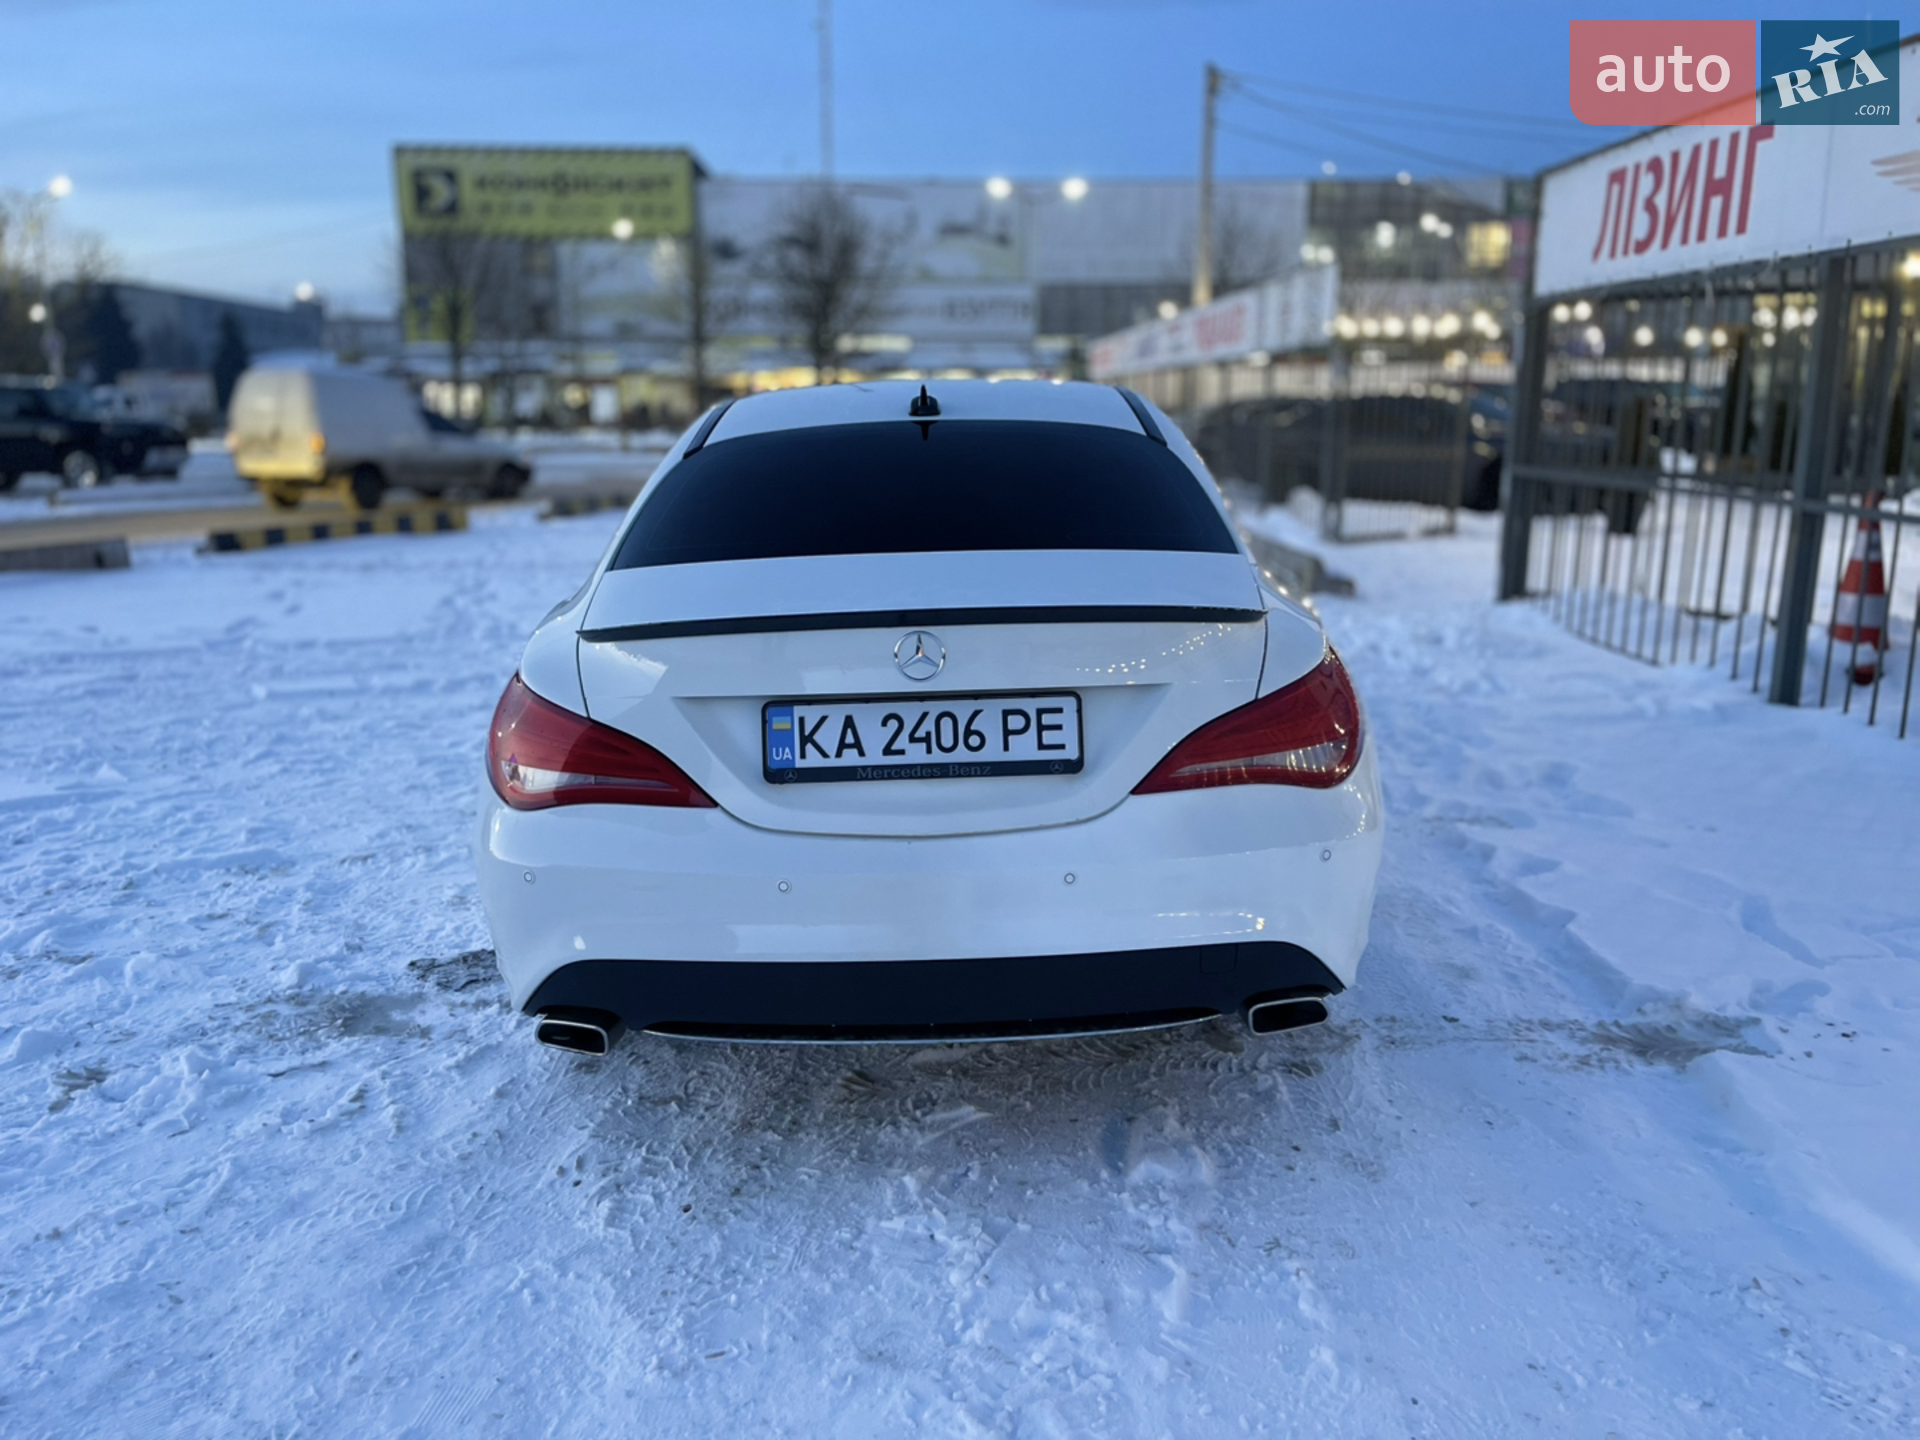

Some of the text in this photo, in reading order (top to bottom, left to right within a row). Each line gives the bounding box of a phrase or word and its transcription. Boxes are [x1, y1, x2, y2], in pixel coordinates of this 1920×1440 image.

[1592, 121, 1775, 263] ЛІЗИНГ
[798, 707, 1066, 760] KA 2406 PE
[772, 747, 793, 761] UA
[856, 764, 991, 780] Mercedes-Benz
